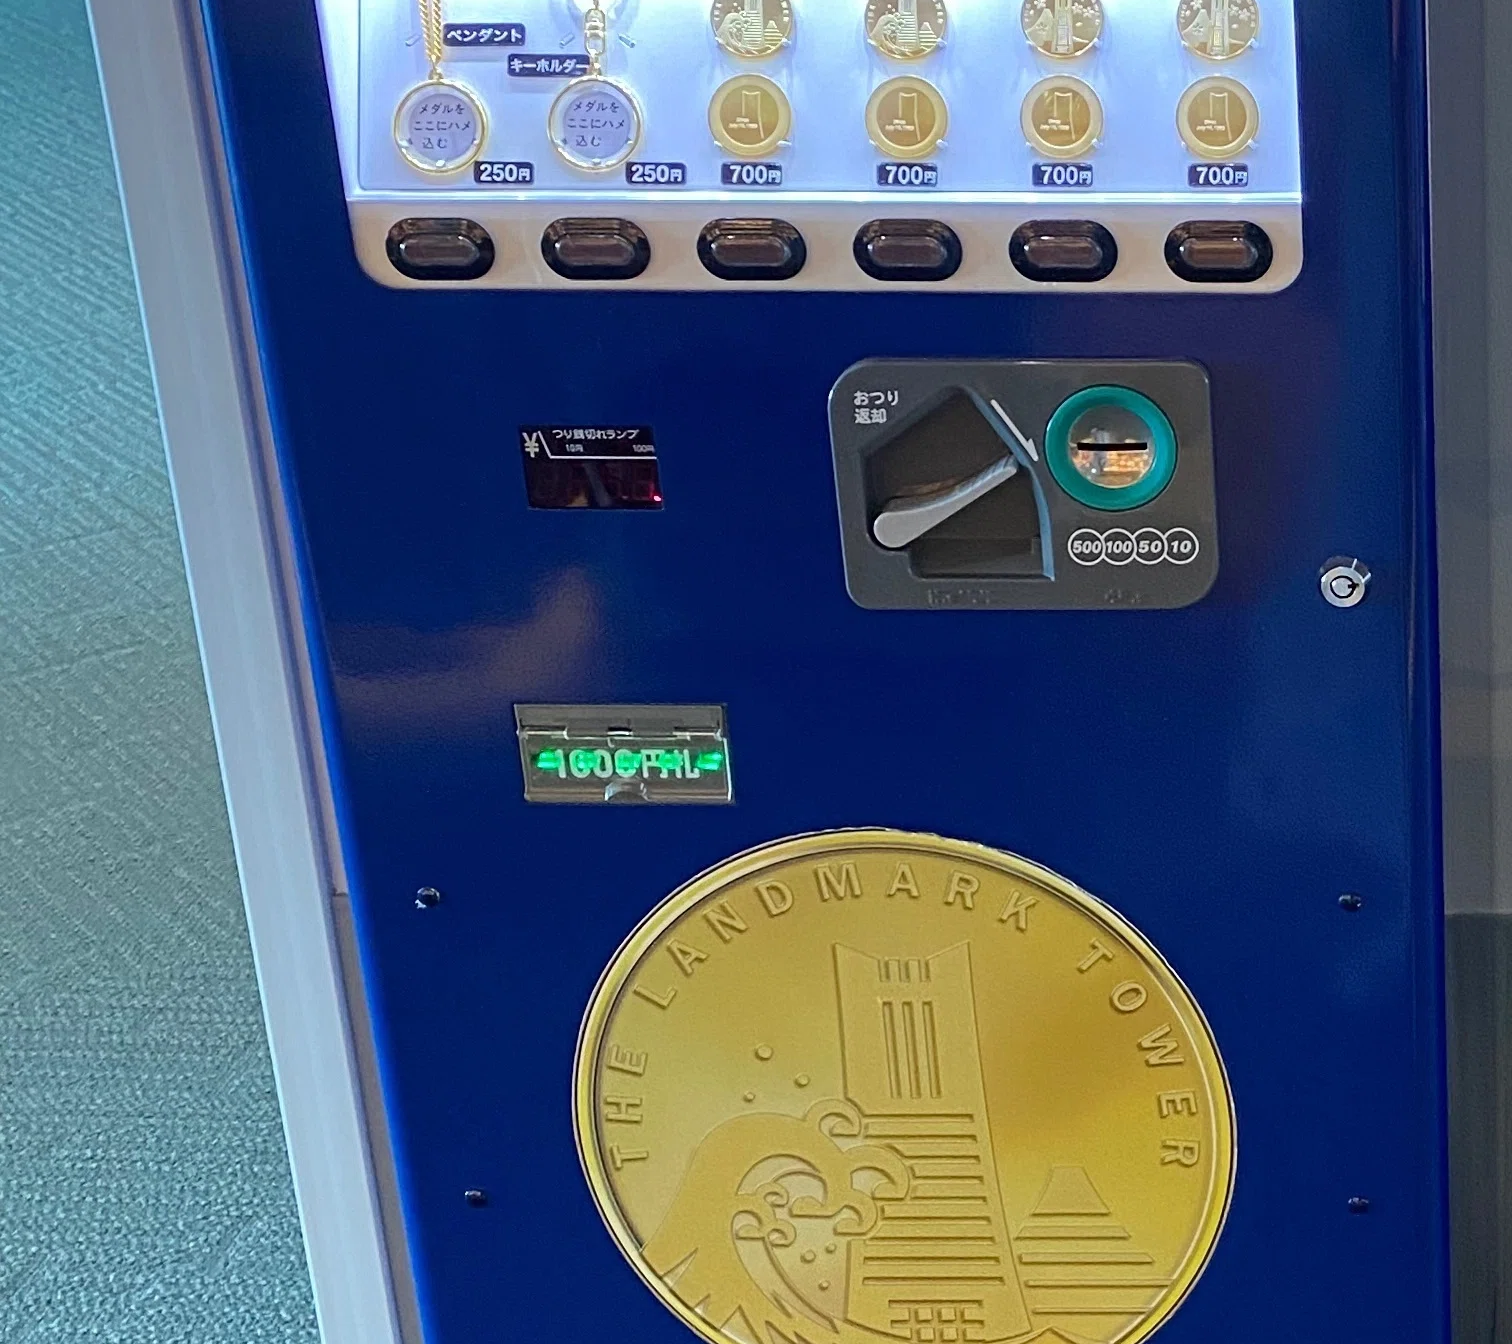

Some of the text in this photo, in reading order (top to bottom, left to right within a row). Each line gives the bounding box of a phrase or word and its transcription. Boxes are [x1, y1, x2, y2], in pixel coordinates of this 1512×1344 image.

[446, 27, 523, 43] ペンダント
[509, 57, 590, 74] キーホルダー
[419, 103, 465, 115] メダルを
[573, 101, 620, 114] メダルを
[413, 120, 472, 132] ここにハメ
[567, 118, 626, 130] ここにハメ
[421, 137, 449, 150] 込む
[575, 134, 602, 147] 込む
[479, 164, 531, 182] 250円
[631, 163, 684, 182] 250円
[729, 165, 782, 184] 700円
[885, 165, 937, 185] 700円
[1040, 165, 1092, 185] 700円
[1196, 166, 1248, 185] 700円
[853, 390, 899, 406] おつり
[853, 407, 888, 424] 返却
[551, 428, 640, 440] つり銭切れランプ
[1072, 539, 1192, 554] 500 100 50 10
[603, 859, 1202, 1173] THE LANDMARK TOWER
